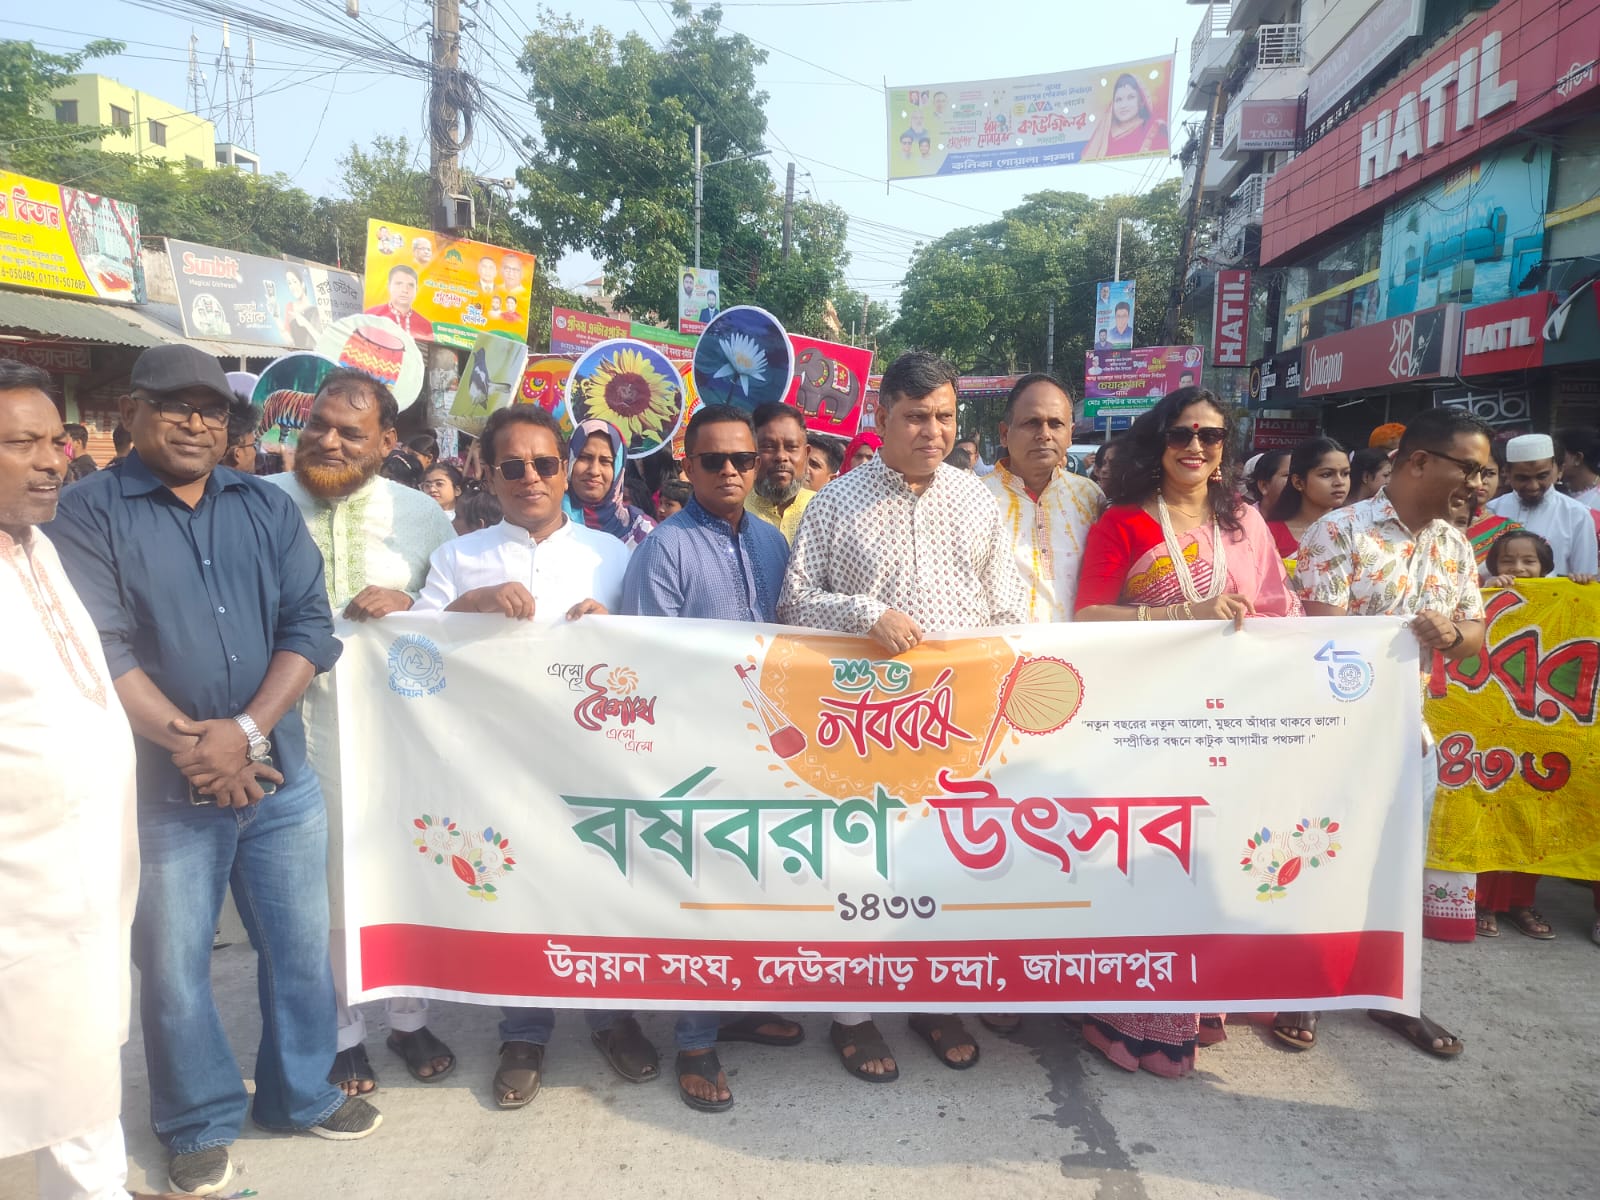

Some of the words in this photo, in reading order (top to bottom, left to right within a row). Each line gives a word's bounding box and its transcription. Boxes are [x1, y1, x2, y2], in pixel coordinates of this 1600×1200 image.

[1359, 31, 1518, 188] HATIL
[1248, 129, 1295, 139] TANIN
[12, 185, 61, 231] বিতান
[183, 250, 239, 279] Sunbit
[1220, 273, 1245, 363] HATIL
[1465, 317, 1536, 356] HATIL
[1304, 345, 1343, 392] Shwapno
[547, 663, 584, 682] এসো
[829, 658, 912, 692] শুভ
[574, 663, 657, 731] বৈশাখ
[817, 668, 974, 756] নববর্ষ
[1113, 719, 1147, 730] বছরের
[1150, 719, 1175, 732] নতুন
[1178, 718, 1212, 730] আলো,
[1215, 718, 1243, 732] মুছবে
[1245, 715, 1277, 729] আঁধার
[1280, 716, 1311, 728] থাকবে
[1113, 733, 1160, 748] সম্প্রীতির
[1163, 736, 1191, 747] বন্ধনে
[1194, 734, 1224, 748] কাটুক
[1226, 733, 1268, 747] আগামীর
[1436, 733, 1572, 793] ৪৩৩
[561, 767, 906, 883] বর্ষবরণ
[925, 769, 1210, 879] উৎসব
[837, 892, 936, 922] ১৪৩৩
[544, 940, 651, 990] উন্নয়ন
[660, 952, 741, 992] সংঘ,
[755, 946, 917, 993] দেউরপাড়
[928, 947, 1005, 993] চন্দ্রা,
